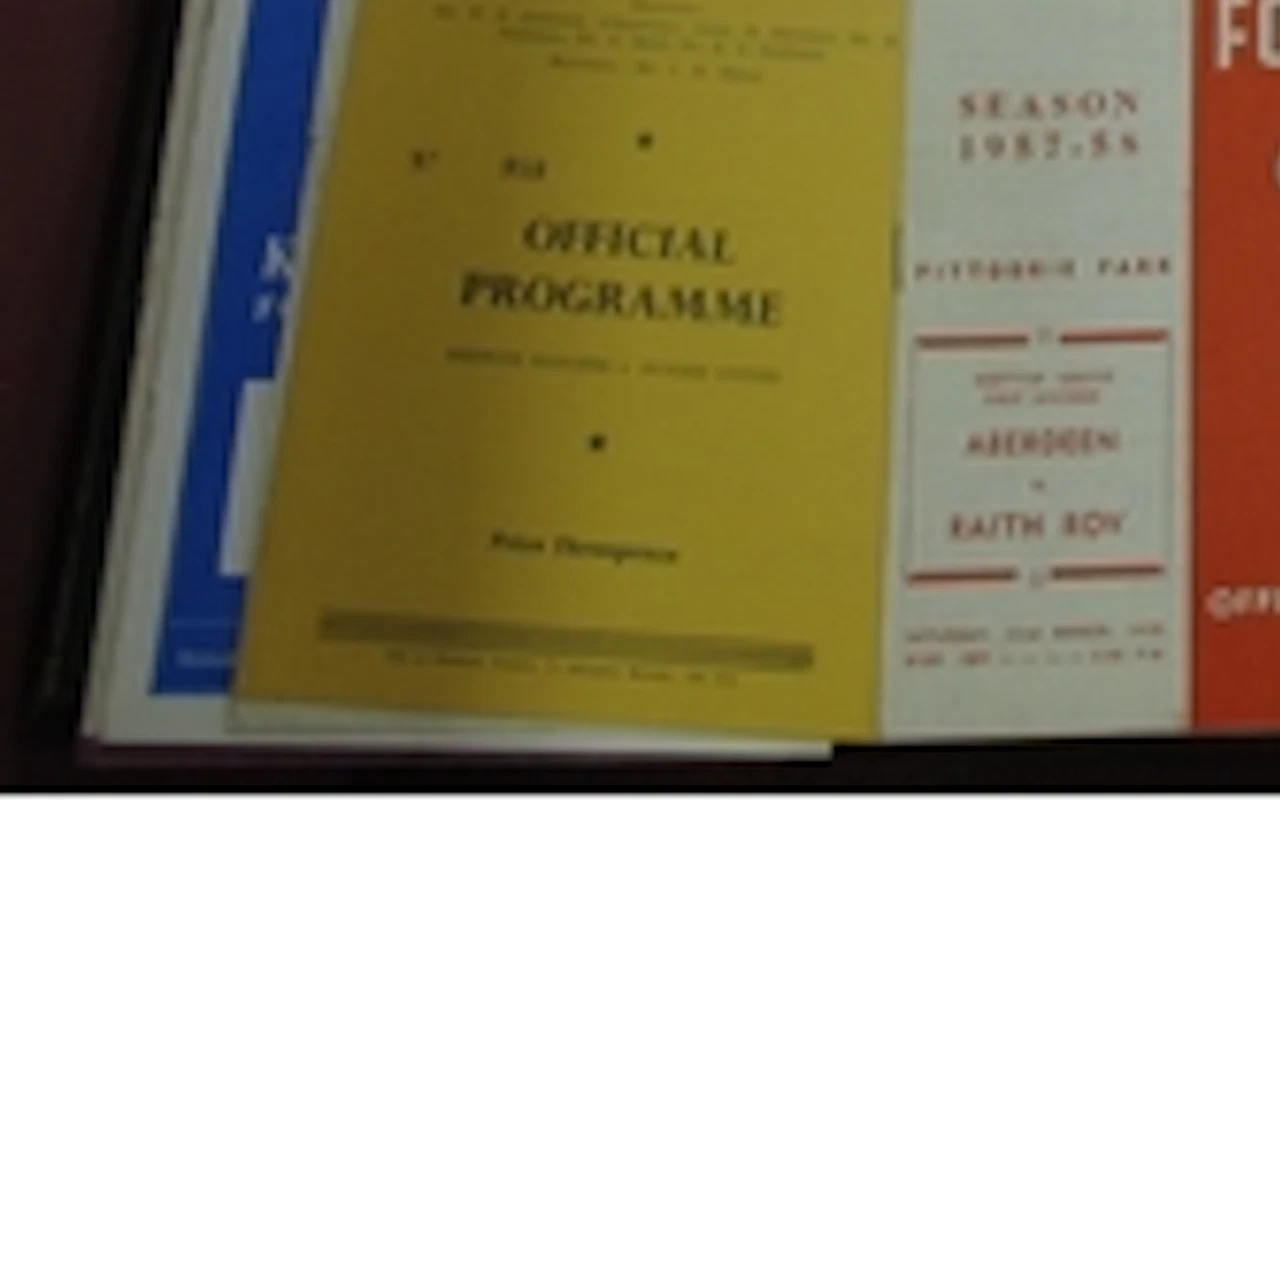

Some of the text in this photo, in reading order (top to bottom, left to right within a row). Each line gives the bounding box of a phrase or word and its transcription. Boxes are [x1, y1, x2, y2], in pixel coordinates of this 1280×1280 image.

[956, 88, 1140, 121] SEASON
[522, 214, 737, 266] OFFICIAL
[1096, 256, 1173, 278] PARK
[458, 268, 785, 328] PROGRAMME
[965, 428, 1121, 458] ABERDEEN
[950, 510, 1045, 541] RAITH
